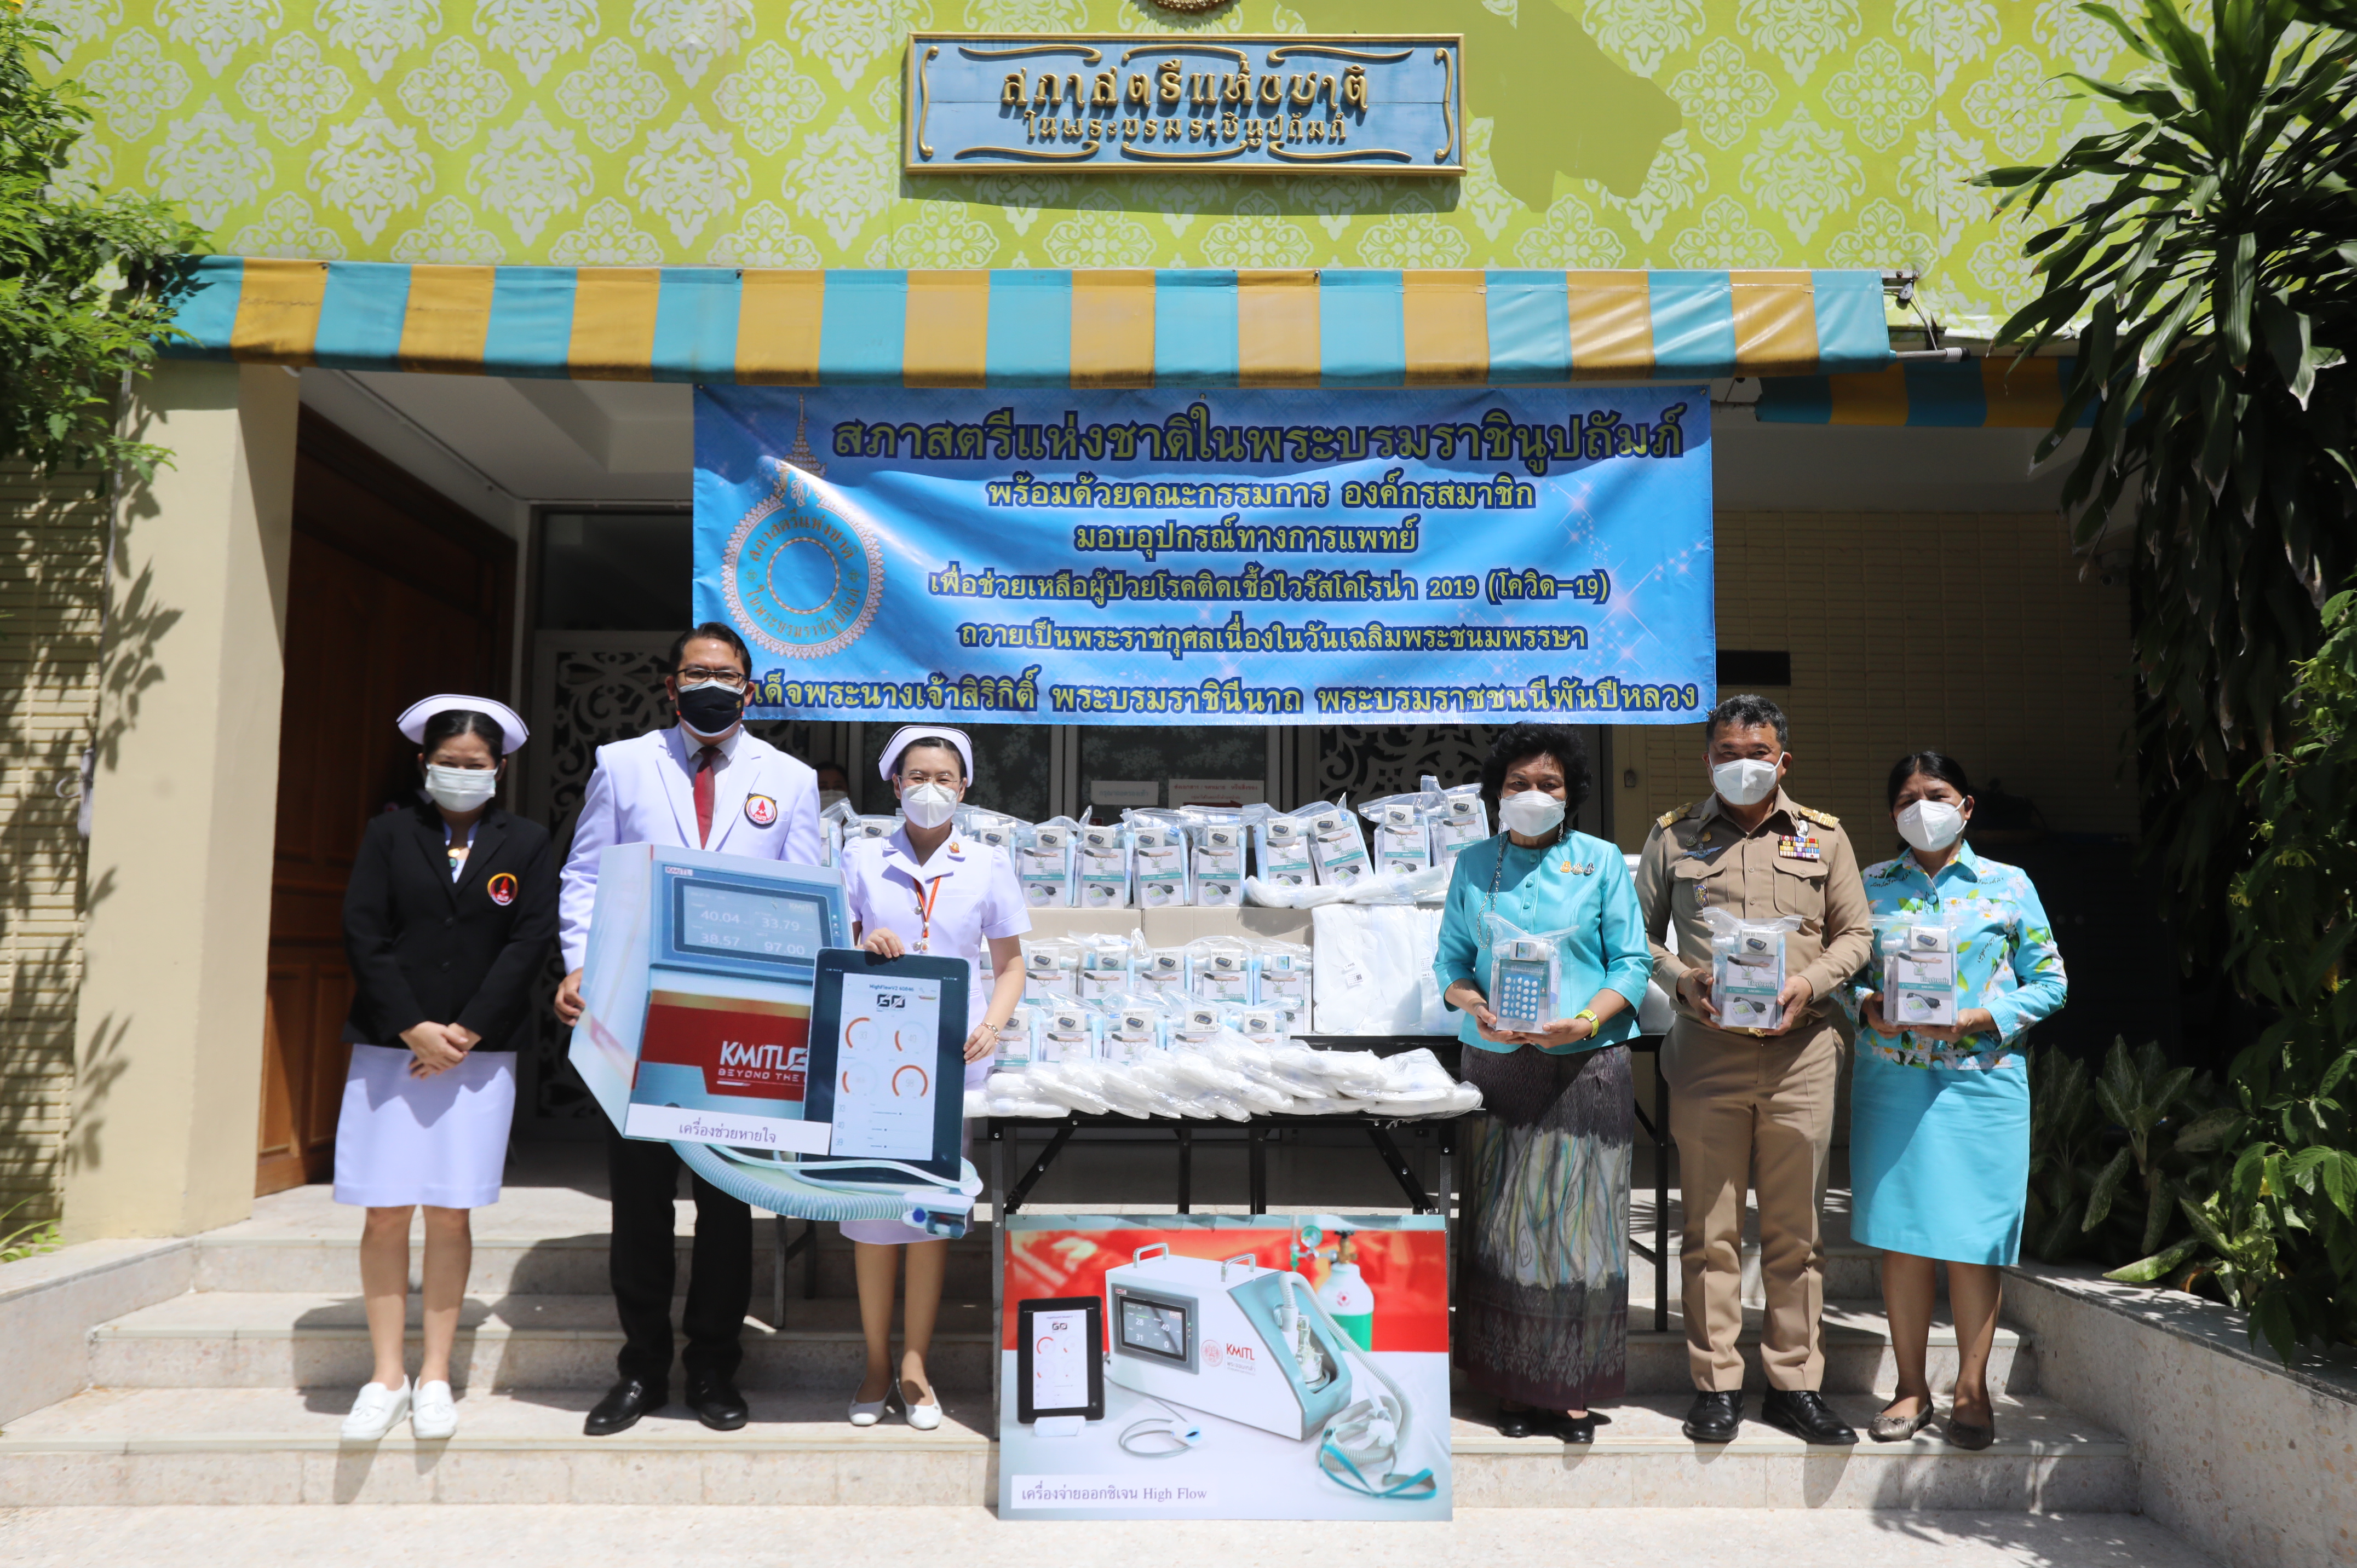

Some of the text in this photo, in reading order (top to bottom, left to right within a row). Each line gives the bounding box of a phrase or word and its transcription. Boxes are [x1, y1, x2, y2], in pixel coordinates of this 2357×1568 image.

[1001, 59, 1369, 113] สภาสตรีแห่งชาติ
[835, 404, 1683, 475] สภาสตรีแห่งชาติในพระบรมราชินูปถัมภ์
[988, 468, 1534, 506] พร้อมด้วยคณะกรรมการ องค์กรสมาชิก
[1076, 515, 1418, 558] มอบอุปกรณ์ทางการแพทย์
[930, 563, 1608, 606] เพื่อช่วยเหลือผู้ป่วยโรคติดเชื้อไวรัสโคโรน่า 2019 (โควิด-19)
[962, 614, 1585, 656] ถวายเป็นพระราชกุศลเนื่องในวันเฉลิมพระชนมพรรษา
[755, 667, 1695, 712] เด็จพระนางเจ้าสิริกิติ์ พระบรมราชินีนาถ พระบรมราชชนนีพันปีหลวง
[1340, 846, 1360, 856] Electronic
[700, 910, 739, 924] 40.04
[762, 918, 800, 931] 33.79
[701, 933, 739, 947] 38.57
[764, 941, 805, 955] 97.00
[877, 994, 905, 1008] GO
[720, 1040, 808, 1072] KMITLG
[718, 1068, 800, 1082] BEYOND THE
[679, 1117, 777, 1143] เครื่องช่วยหายใจ
[1135, 1318, 1144, 1326] 28
[1161, 1324, 1170, 1332] 40
[1226, 1343, 1255, 1361] KMITL
[1021, 1480, 1208, 1502] เครื่องจ่ายออกซิเจน High Flow
